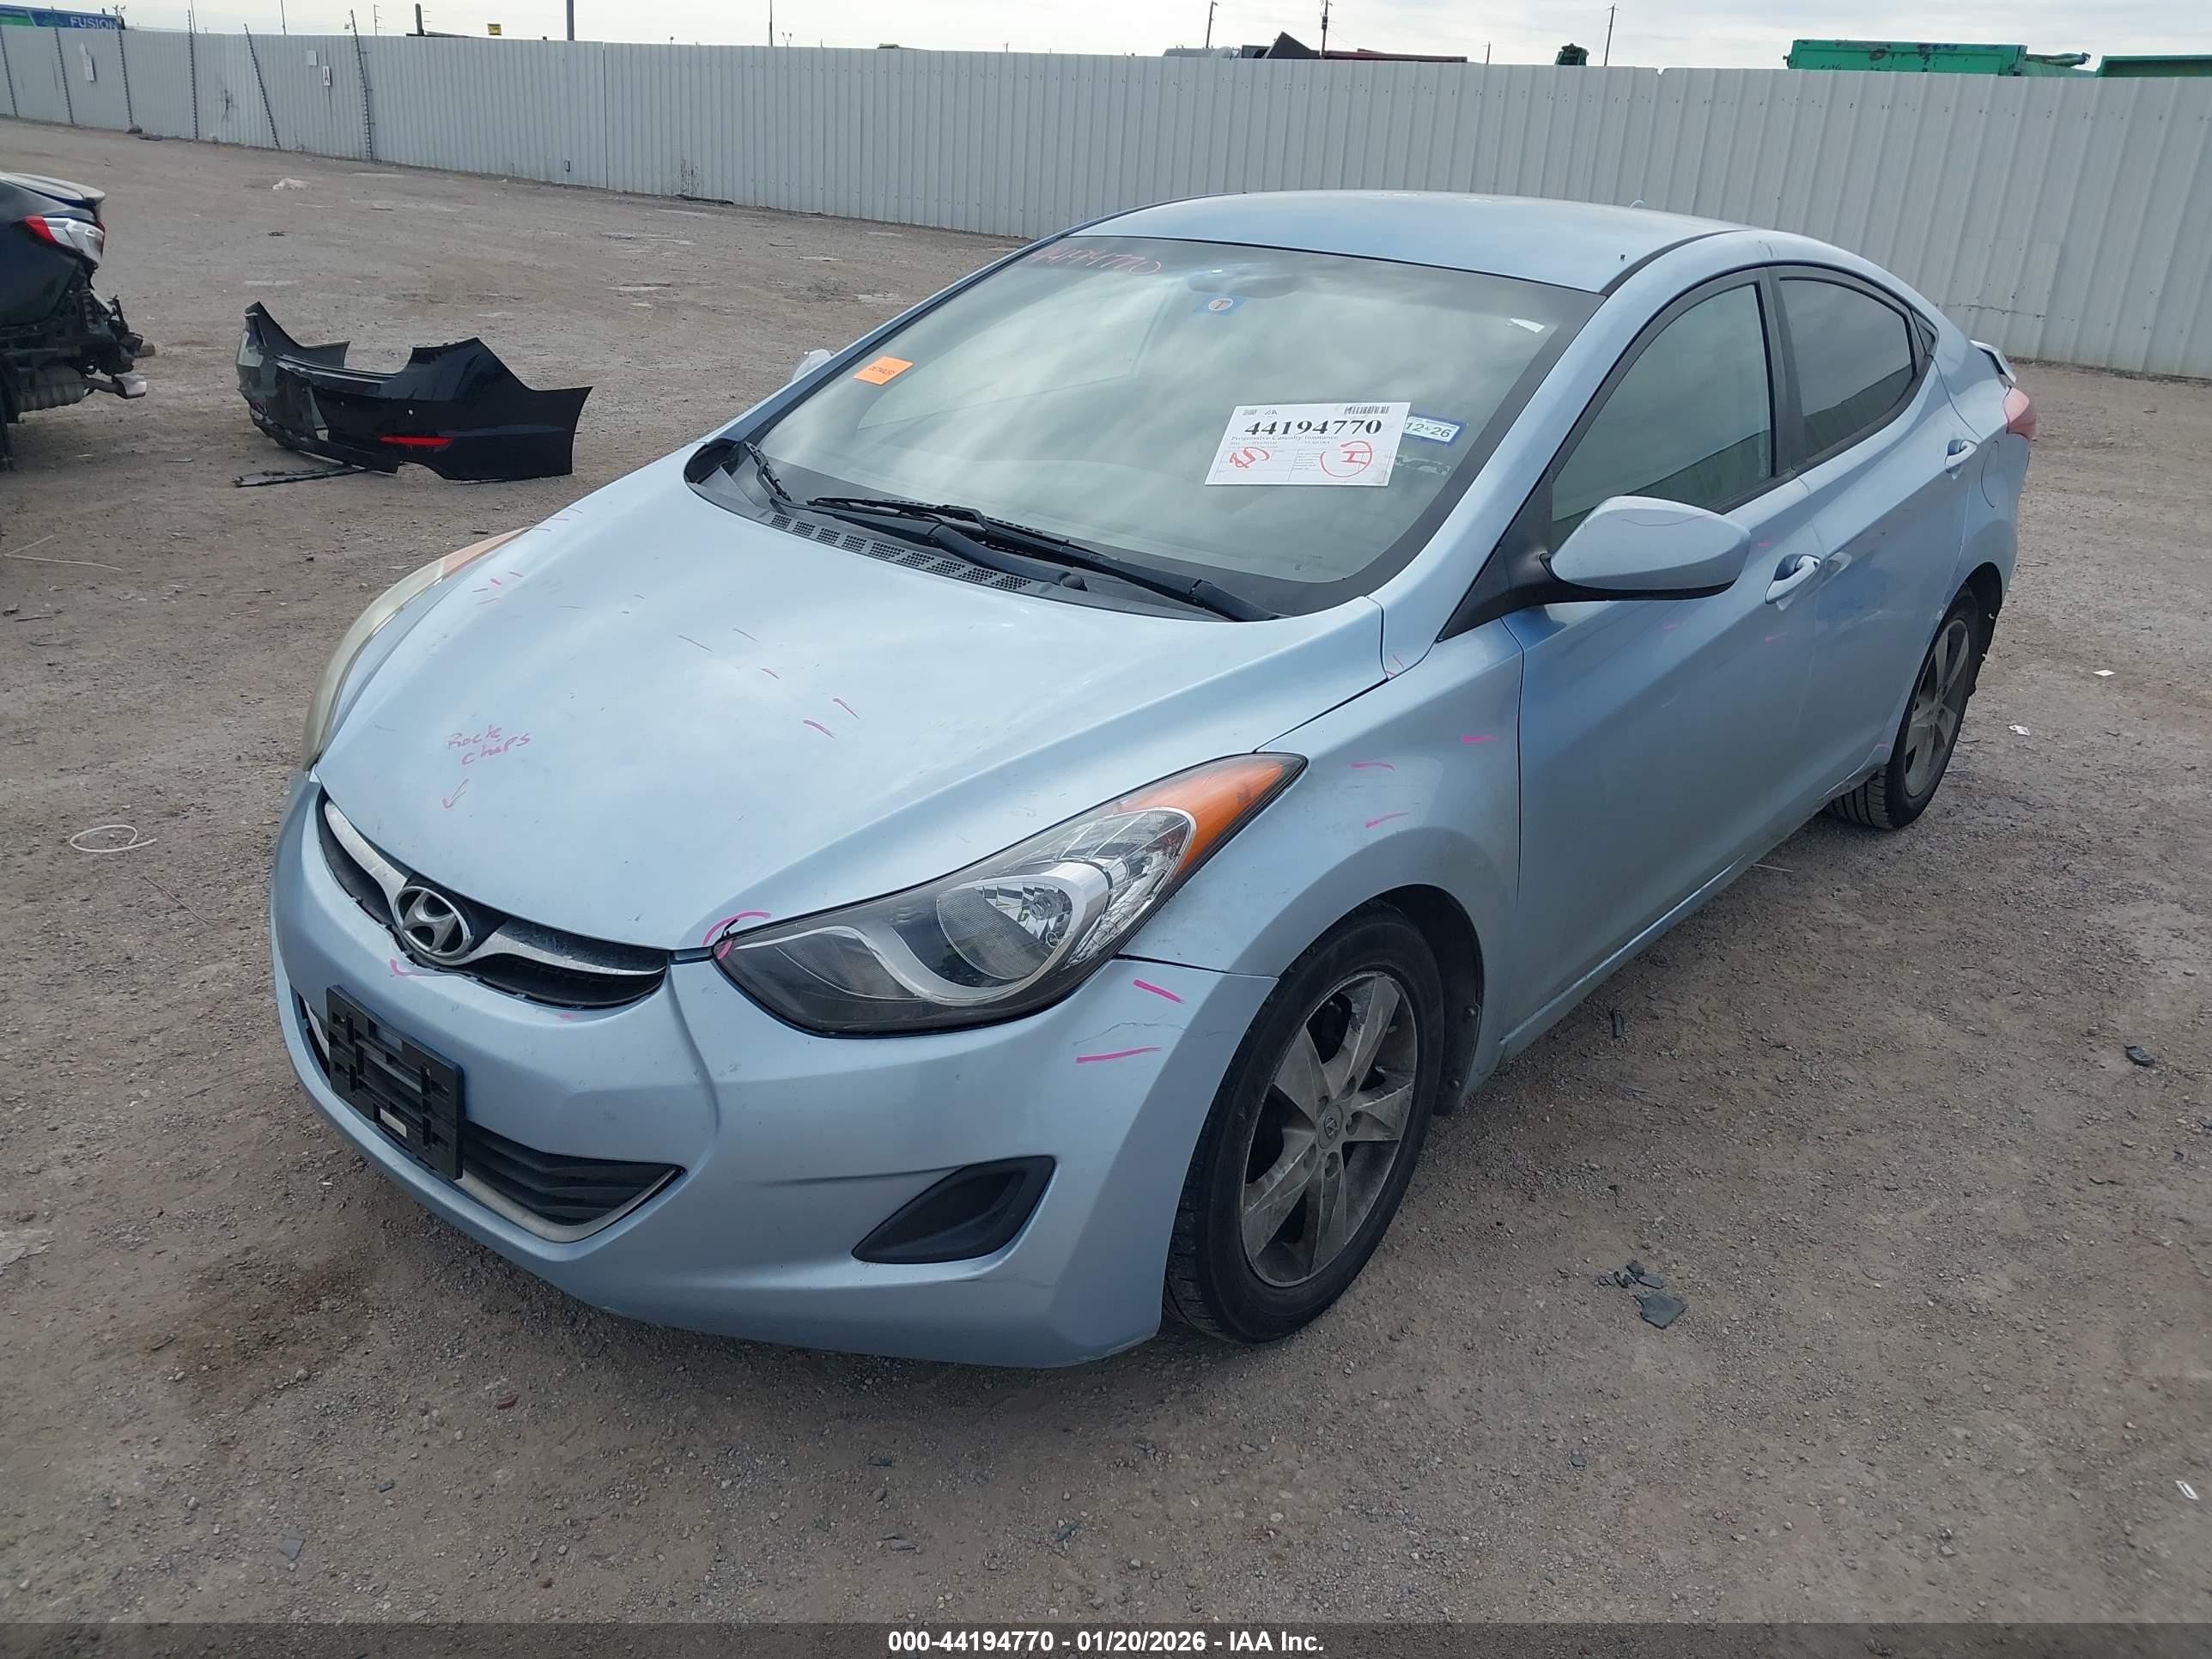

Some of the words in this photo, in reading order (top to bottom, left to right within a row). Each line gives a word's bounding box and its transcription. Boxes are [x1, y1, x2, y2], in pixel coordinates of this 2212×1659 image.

[70, 16, 118, 28] FUSION
[1244, 419, 1382, 435] 44194770
[1429, 426, 1453, 438] 26
